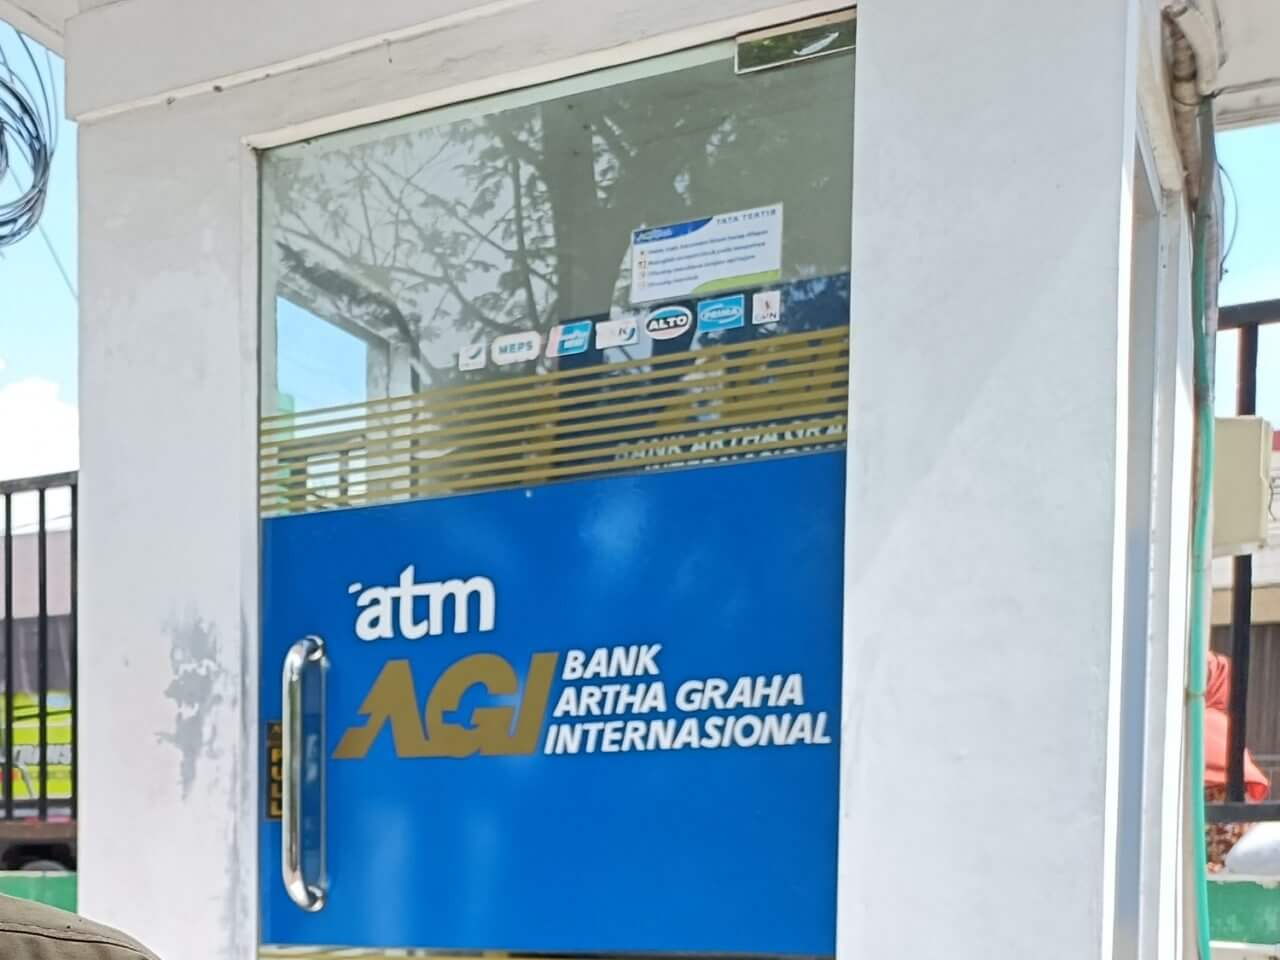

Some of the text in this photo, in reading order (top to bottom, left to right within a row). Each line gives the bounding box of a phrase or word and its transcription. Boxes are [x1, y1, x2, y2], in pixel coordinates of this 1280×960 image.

[648, 315, 688, 330] ALTO
[498, 340, 534, 355] MEPS
[347, 564, 496, 641] atm
[561, 643, 662, 680] BANK
[332, 651, 560, 760] AGI
[552, 673, 804, 717] ARTHA GRAHA
[543, 711, 832, 755] INTERNASIONAL
